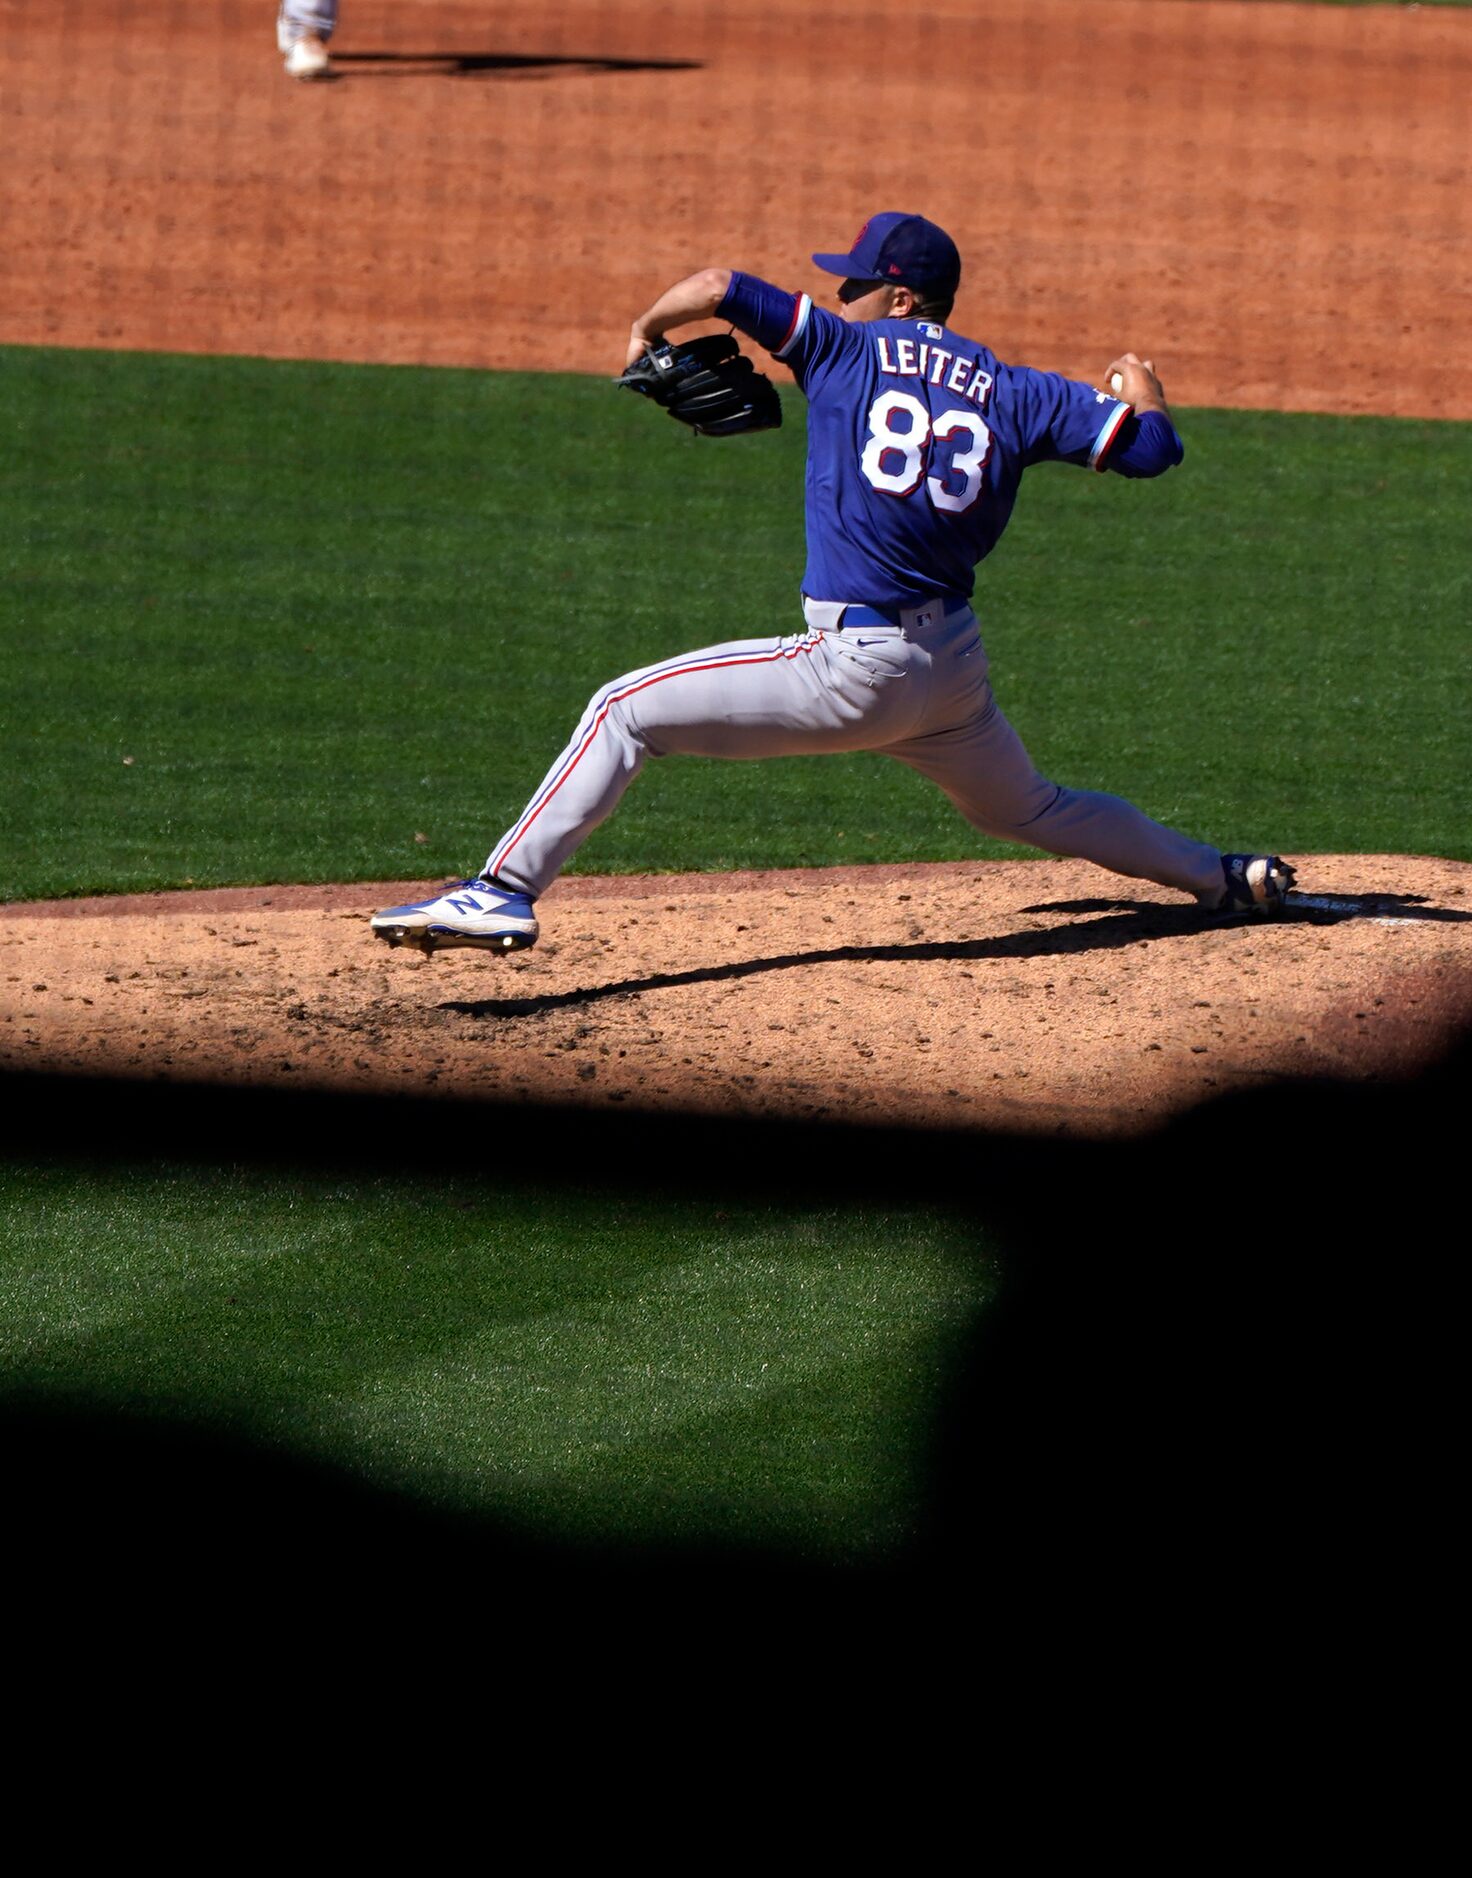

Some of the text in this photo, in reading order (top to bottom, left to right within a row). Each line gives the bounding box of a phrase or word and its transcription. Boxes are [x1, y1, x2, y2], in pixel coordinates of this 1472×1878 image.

[878, 337, 993, 408] LEITER
[862, 391, 994, 514] 83
[445, 894, 484, 915] N
